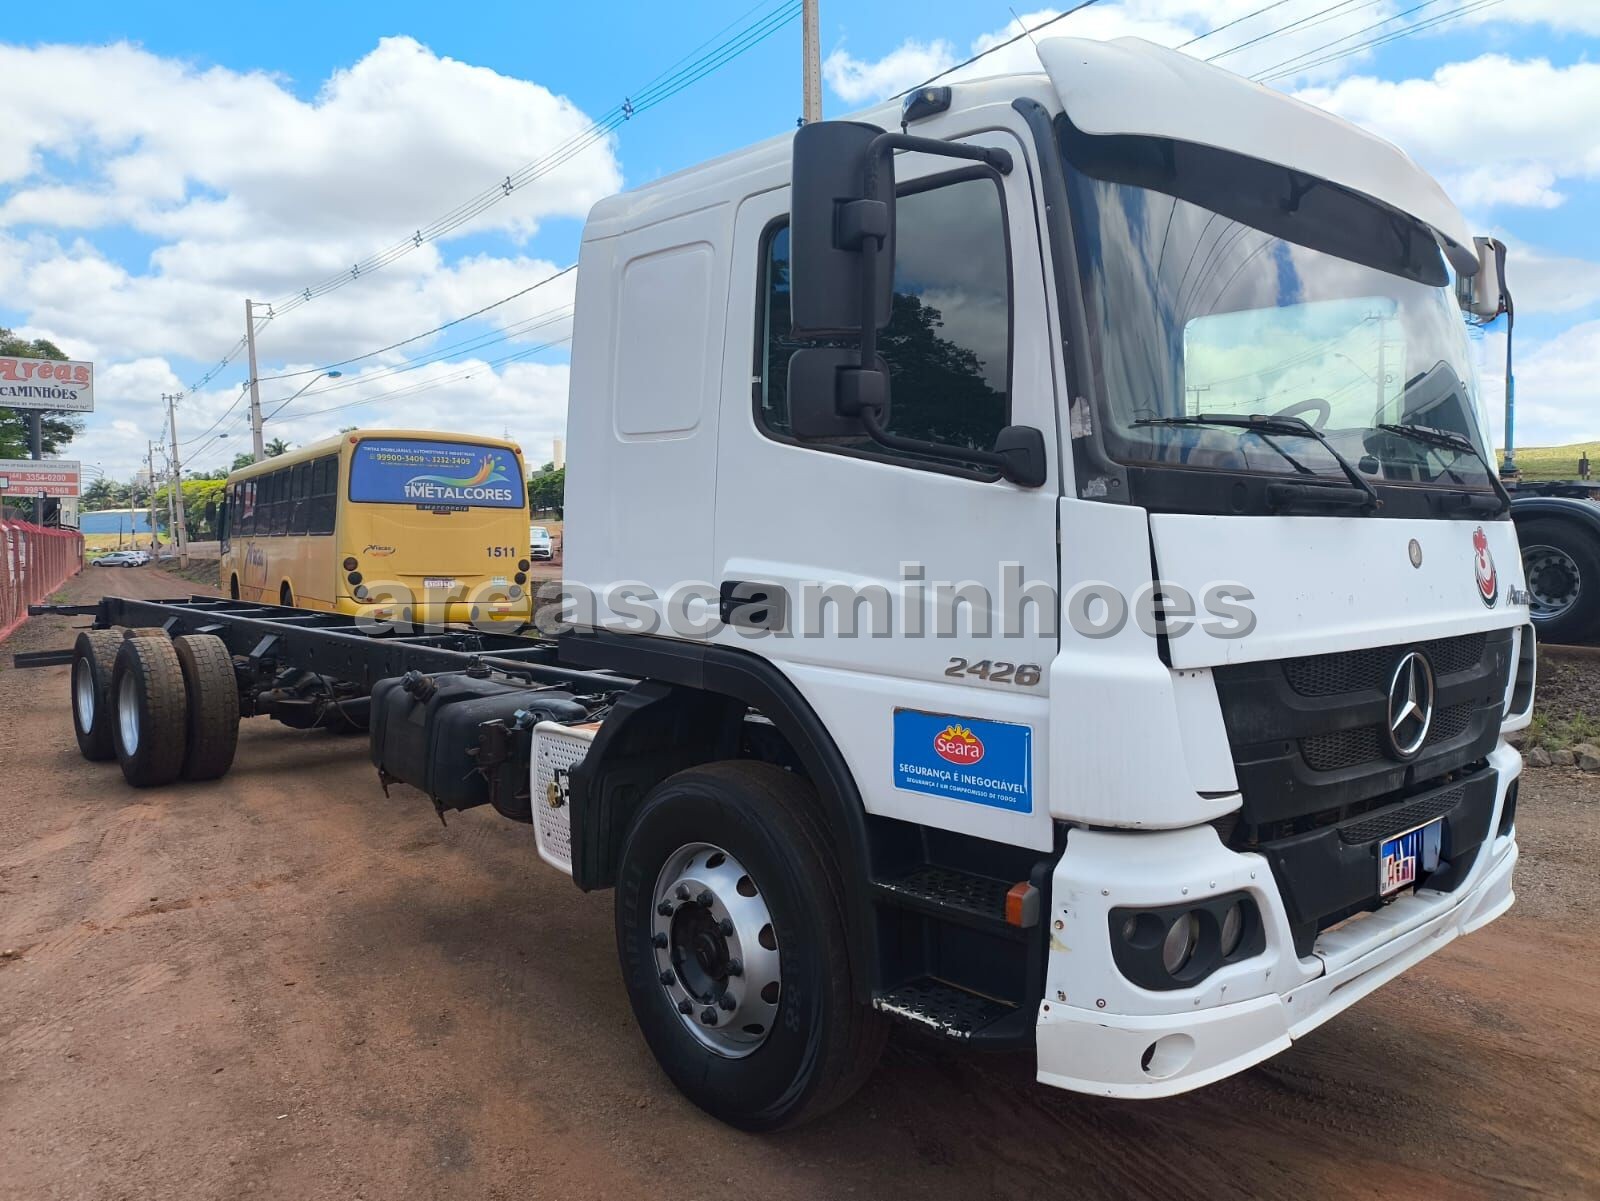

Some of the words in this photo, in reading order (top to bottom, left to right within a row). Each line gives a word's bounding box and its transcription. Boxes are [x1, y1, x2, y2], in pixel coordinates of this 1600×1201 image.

[410, 486, 512, 501] METALCORES
[486, 546, 515, 558] 1511
[944, 656, 1042, 686] 2426
[937, 737, 980, 758] Seara
[899, 762, 951, 781] SEGURANÇA
[953, 769, 959, 782] É
[961, 774, 1025, 794] INEGOCIÁVEL
[906, 776, 935, 788] SEGURANÇA
[949, 784, 988, 798] COMPROMISSO
[997, 793, 1018, 803] TODOS
